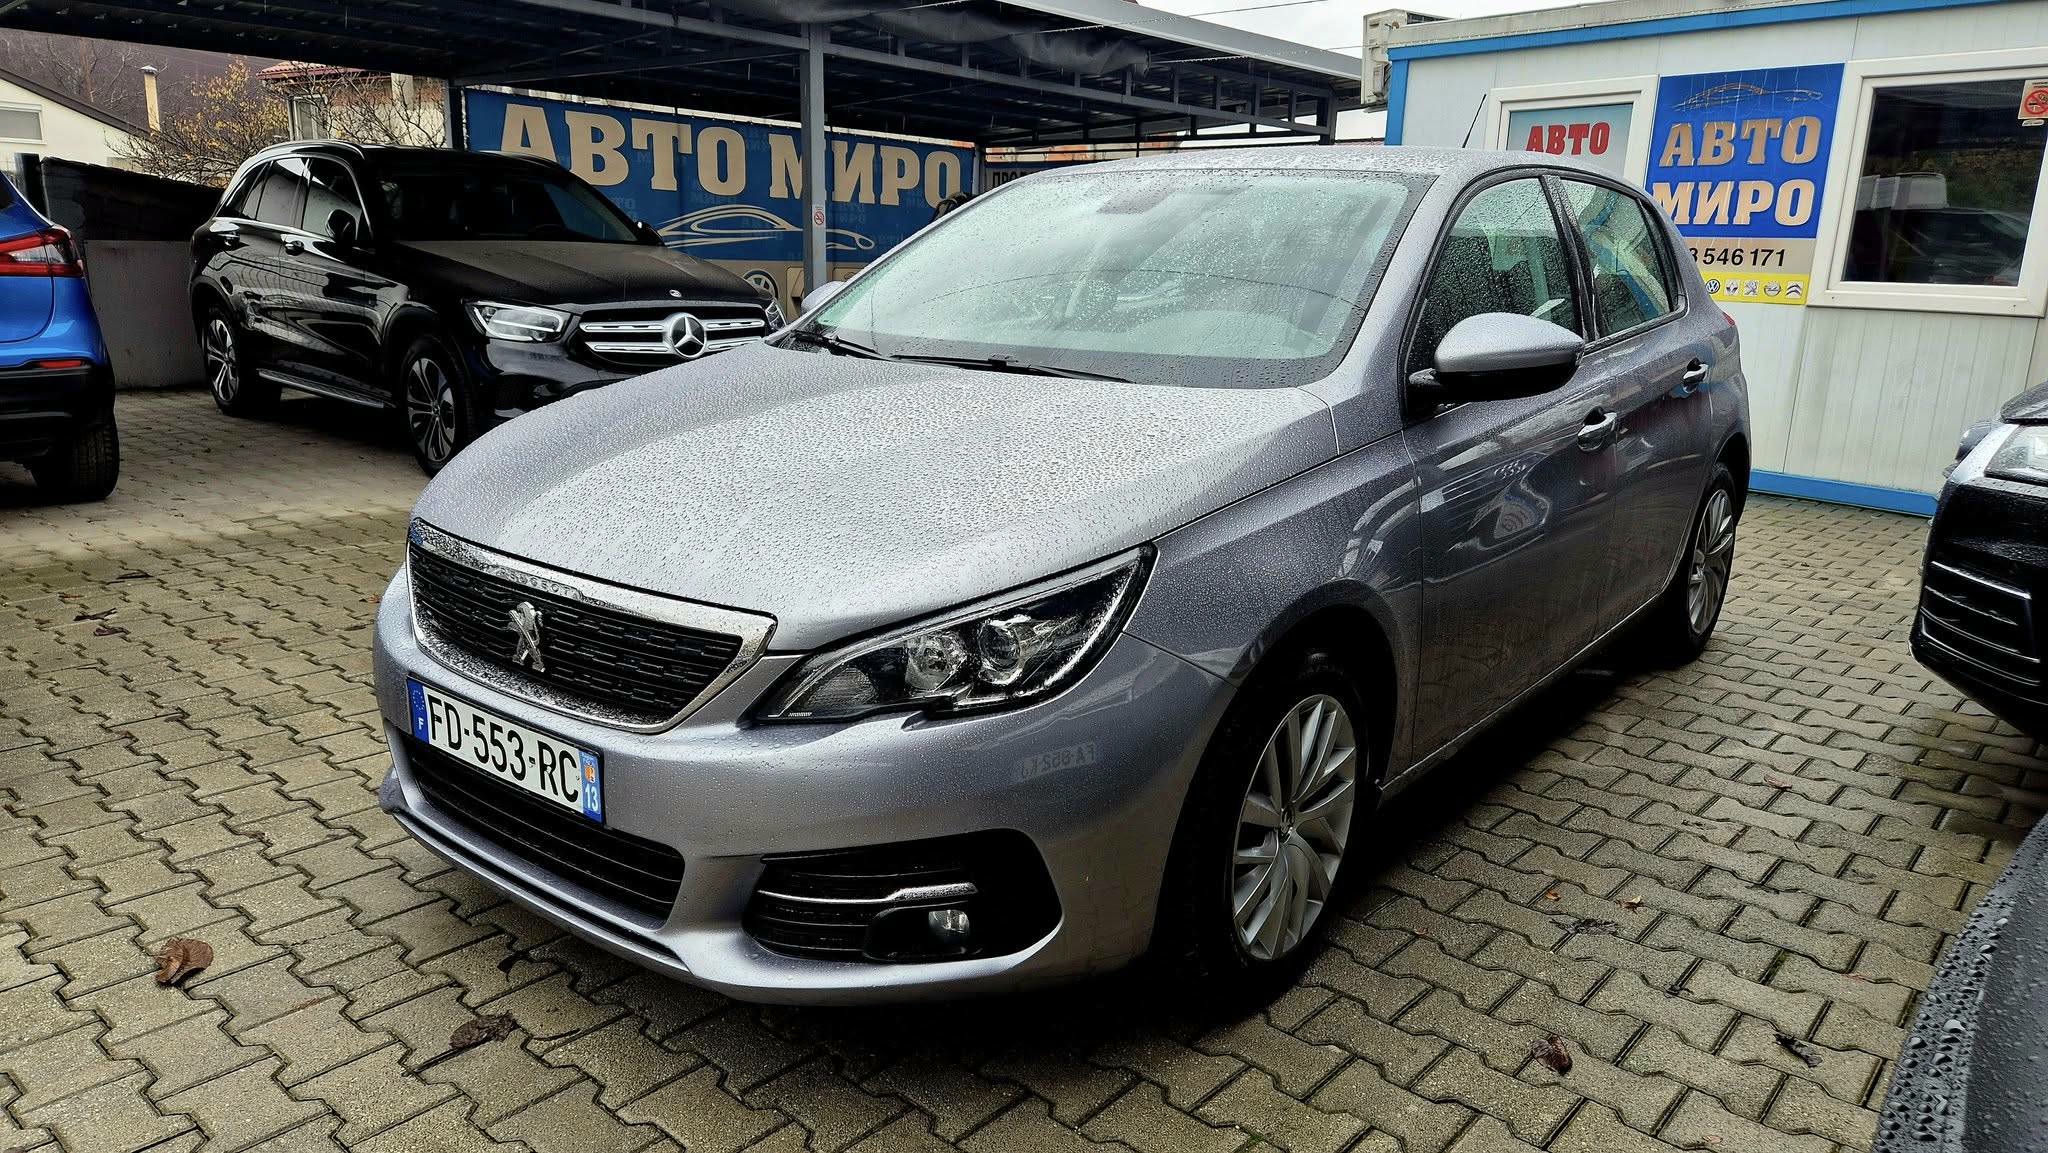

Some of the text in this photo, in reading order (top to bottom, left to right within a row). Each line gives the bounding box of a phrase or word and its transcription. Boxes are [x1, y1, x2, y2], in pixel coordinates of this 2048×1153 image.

[501, 103, 746, 196] АВТО
[1526, 121, 1611, 156] АВТО
[1659, 116, 1821, 167] АВТО
[1653, 179, 1816, 227] МИРО
[1703, 247, 1745, 266] 546
[1750, 248, 1785, 267] 171
[417, 717, 424, 730] F
[427, 693, 579, 804] FD-553-RC
[585, 783, 599, 812] 13
